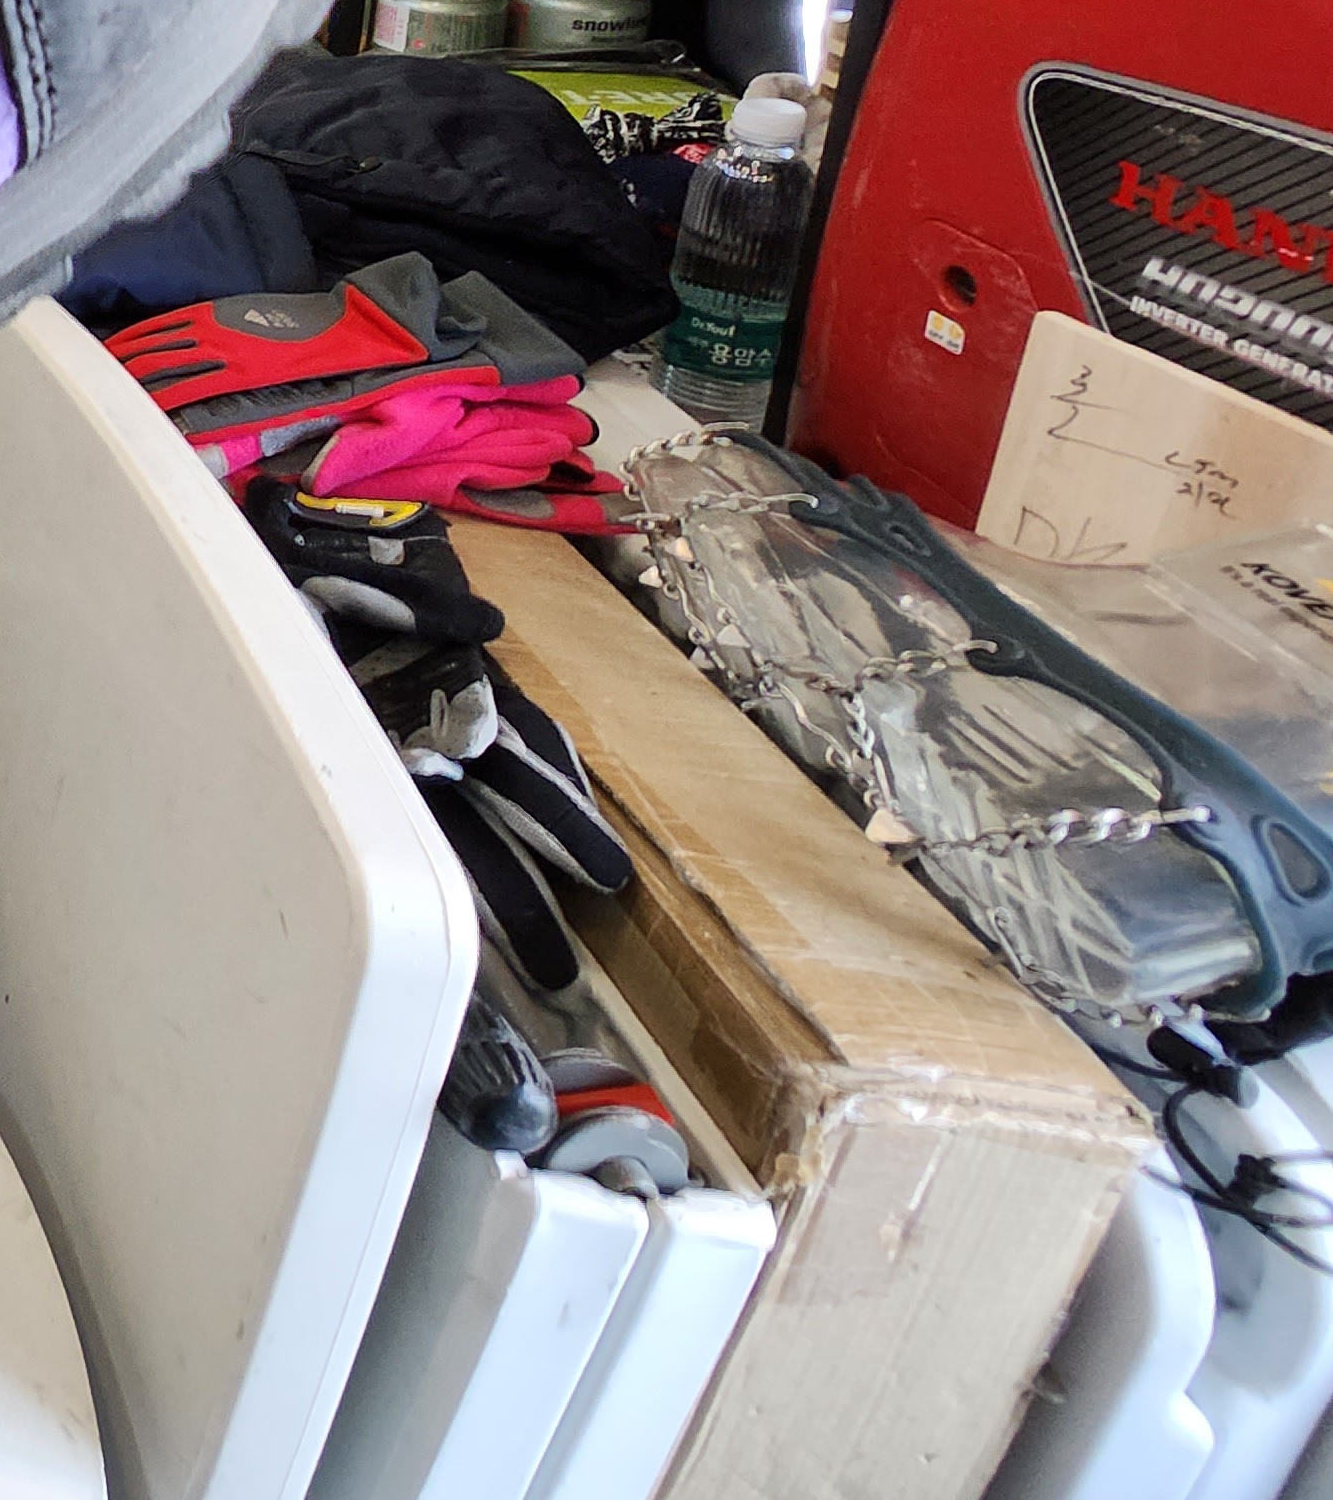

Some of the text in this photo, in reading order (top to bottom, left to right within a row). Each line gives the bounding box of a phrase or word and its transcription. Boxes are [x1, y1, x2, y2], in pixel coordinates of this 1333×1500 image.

[1110, 159, 1333, 286] HAN
[1130, 296, 1229, 347] INVERTER
[709, 342, 773, 368] 용암수
